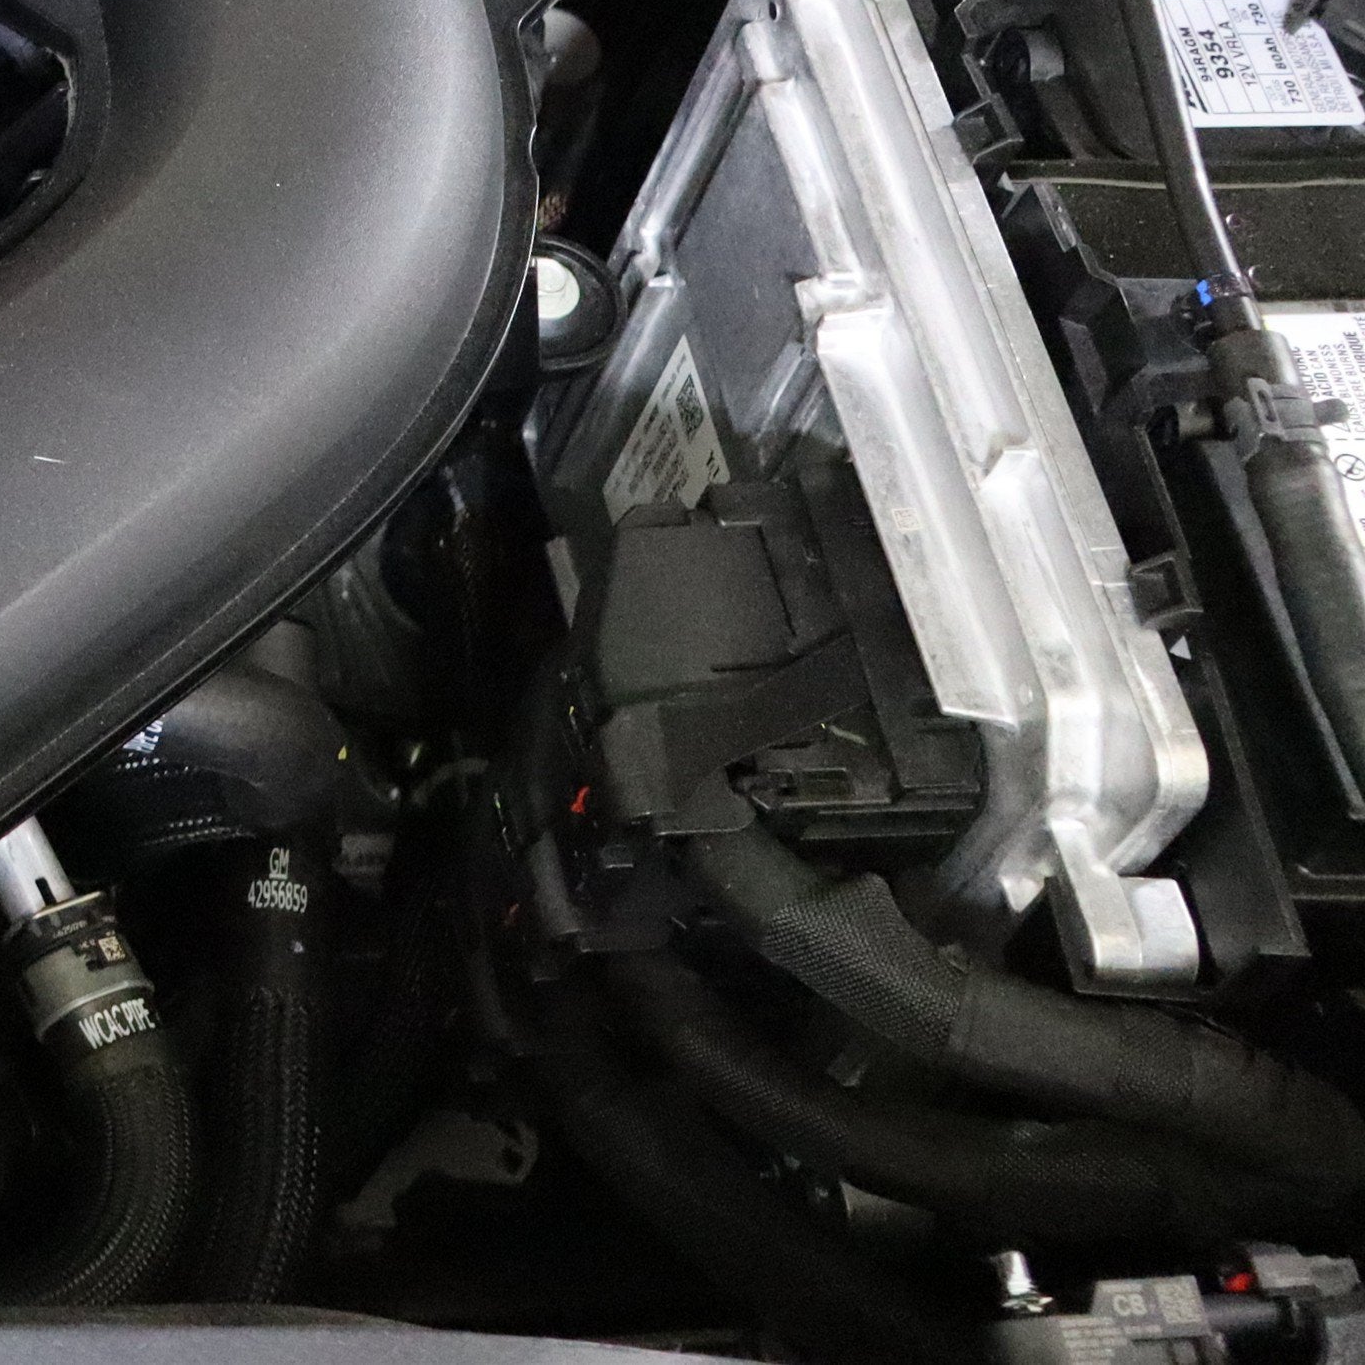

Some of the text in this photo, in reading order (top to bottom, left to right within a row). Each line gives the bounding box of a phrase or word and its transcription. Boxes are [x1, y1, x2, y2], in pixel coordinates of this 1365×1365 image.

[1248, 2, 1267, 26] 730
[1179, 27, 1213, 83] 94RAGM
[1199, 29, 1235, 79] 9354
[1220, 21, 1258, 87] 12V VRLA
[1264, 37, 1287, 70] 80Ah
[1284, 80, 1303, 104] 730
[1306, 349, 1334, 397] ACID CAN
[1318, 344, 1351, 399] BLINDNESS
[1335, 343, 1358, 377] BURNS
[269, 848, 290, 878] GM
[248, 880, 308, 913] 42956859
[78, 1005, 130, 1049] WCAC
